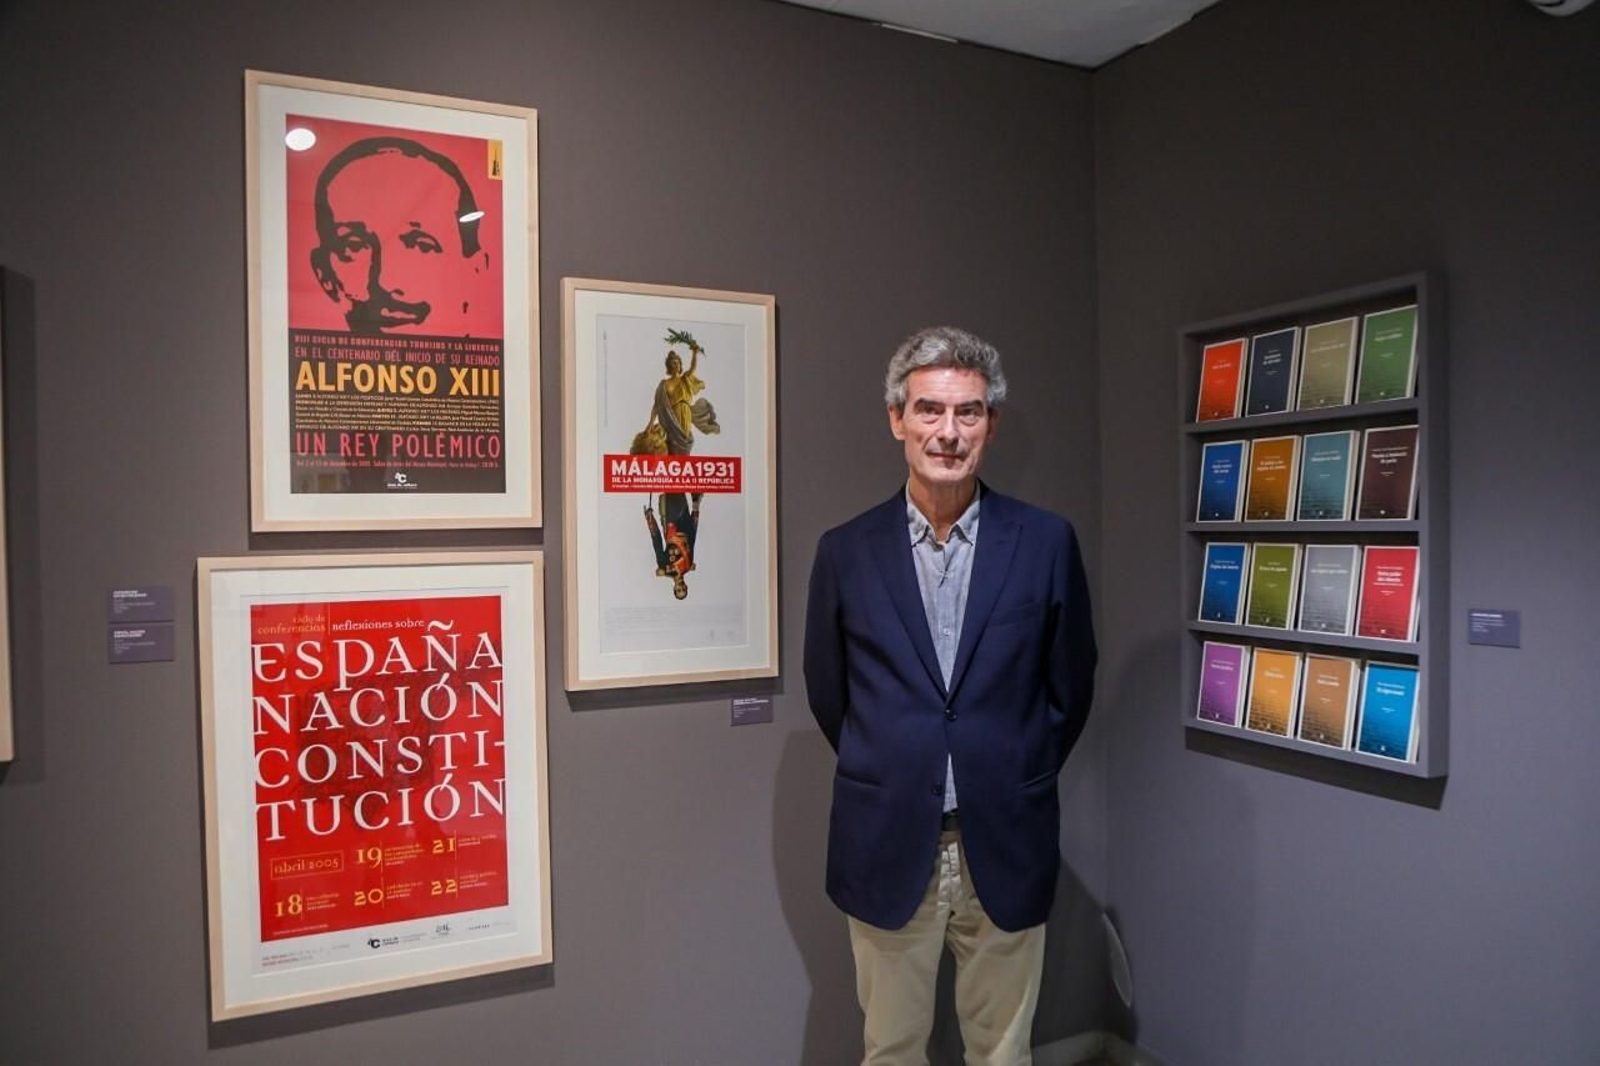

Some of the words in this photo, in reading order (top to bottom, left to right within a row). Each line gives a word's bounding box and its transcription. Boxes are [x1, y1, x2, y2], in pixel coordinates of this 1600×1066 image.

[295, 346, 307, 358] EN
[312, 347, 321, 358] EL
[328, 348, 380, 360] CENTENARIO
[385, 350, 401, 362] DEL
[405, 351, 431, 362] INICIO
[436, 352, 446, 364] DE
[451, 353, 461, 365] SU
[465, 354, 500, 366] REINADO
[295, 360, 437, 395] ALFONSO
[449, 366, 500, 397] XIII
[296, 431, 327, 456] UN
[340, 432, 380, 457] REY
[392, 431, 501, 459] POLÉMICO
[698, 476, 735, 484] REPÚBLICA
[257, 623, 326, 635] conferencias
[395, 617, 425, 629] sobre
[251, 619, 504, 692] ESPAÑA
[252, 672, 504, 735] NACIÓN
[255, 730, 506, 788] CONSTI-
[256, 773, 506, 841] TUCIÓN
[432, 837, 456, 854] 21
[309, 857, 339, 870] 2005
[356, 847, 382, 869] 19
[354, 888, 384, 907] 20
[431, 878, 457, 896] 22
[275, 893, 303, 917] 18
